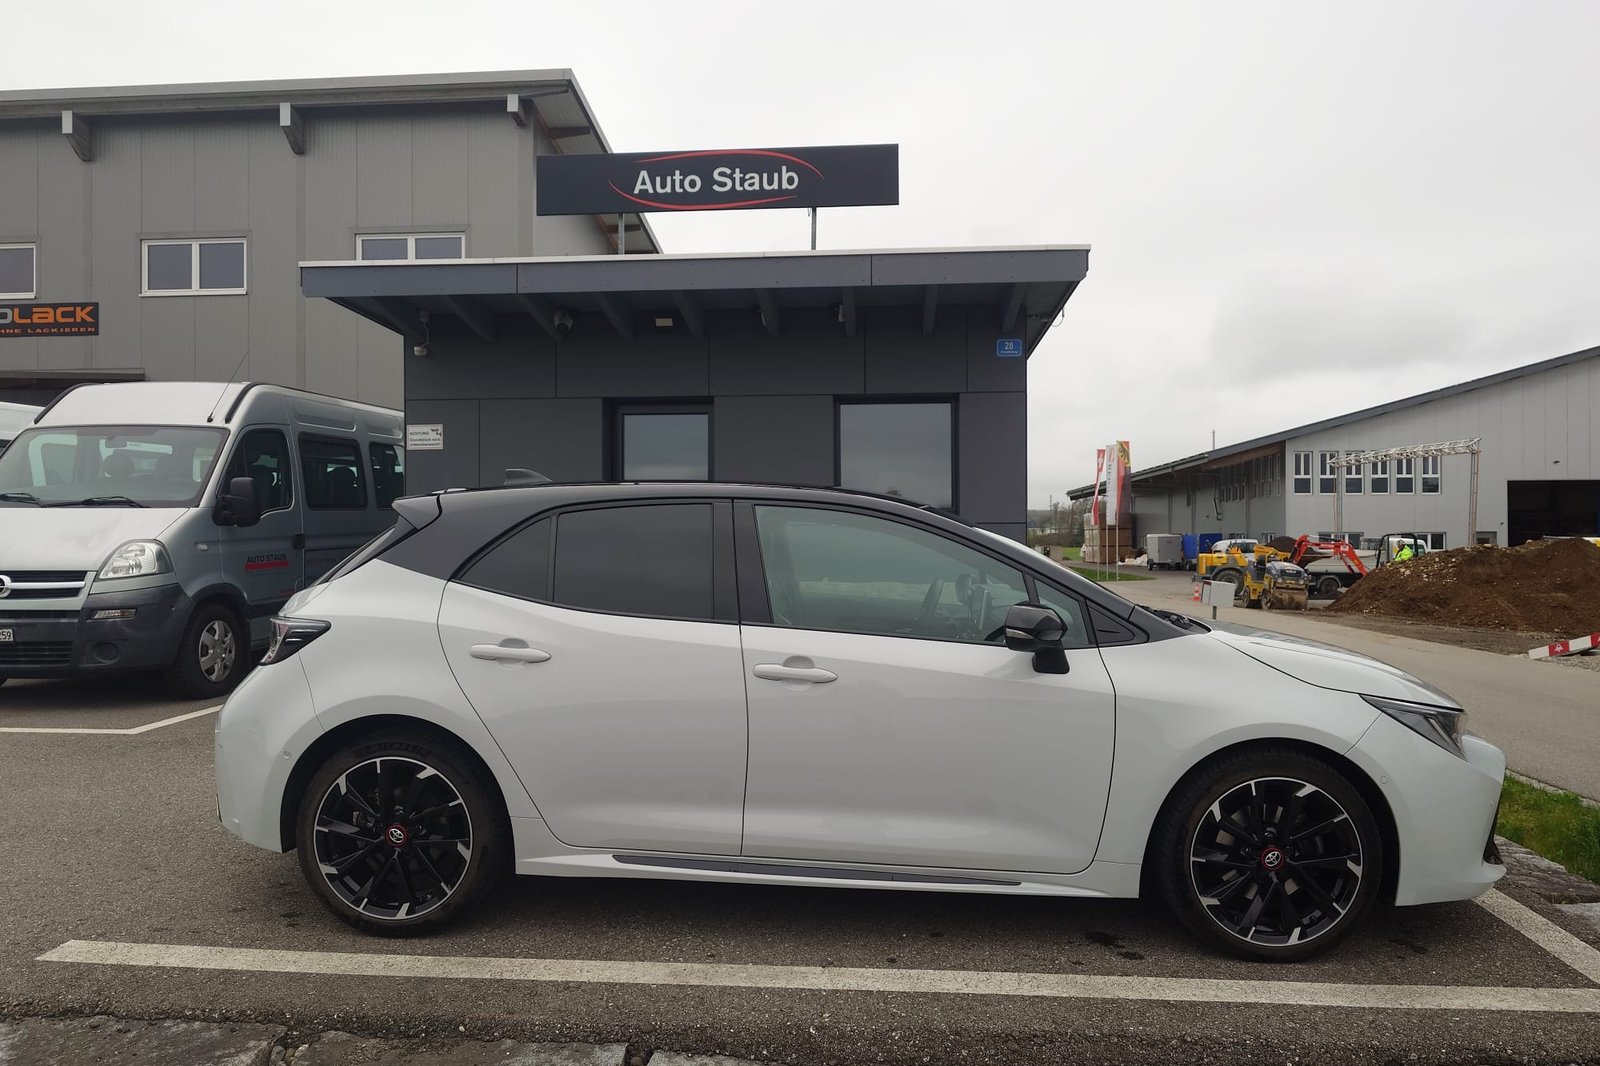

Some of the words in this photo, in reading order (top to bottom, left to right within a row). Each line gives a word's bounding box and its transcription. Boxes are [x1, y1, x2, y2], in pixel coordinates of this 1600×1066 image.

[633, 170, 702, 194] Auto
[712, 165, 799, 192] Staub
[1004, 341, 1014, 350] 28
[247, 555, 265, 563] AUTO
